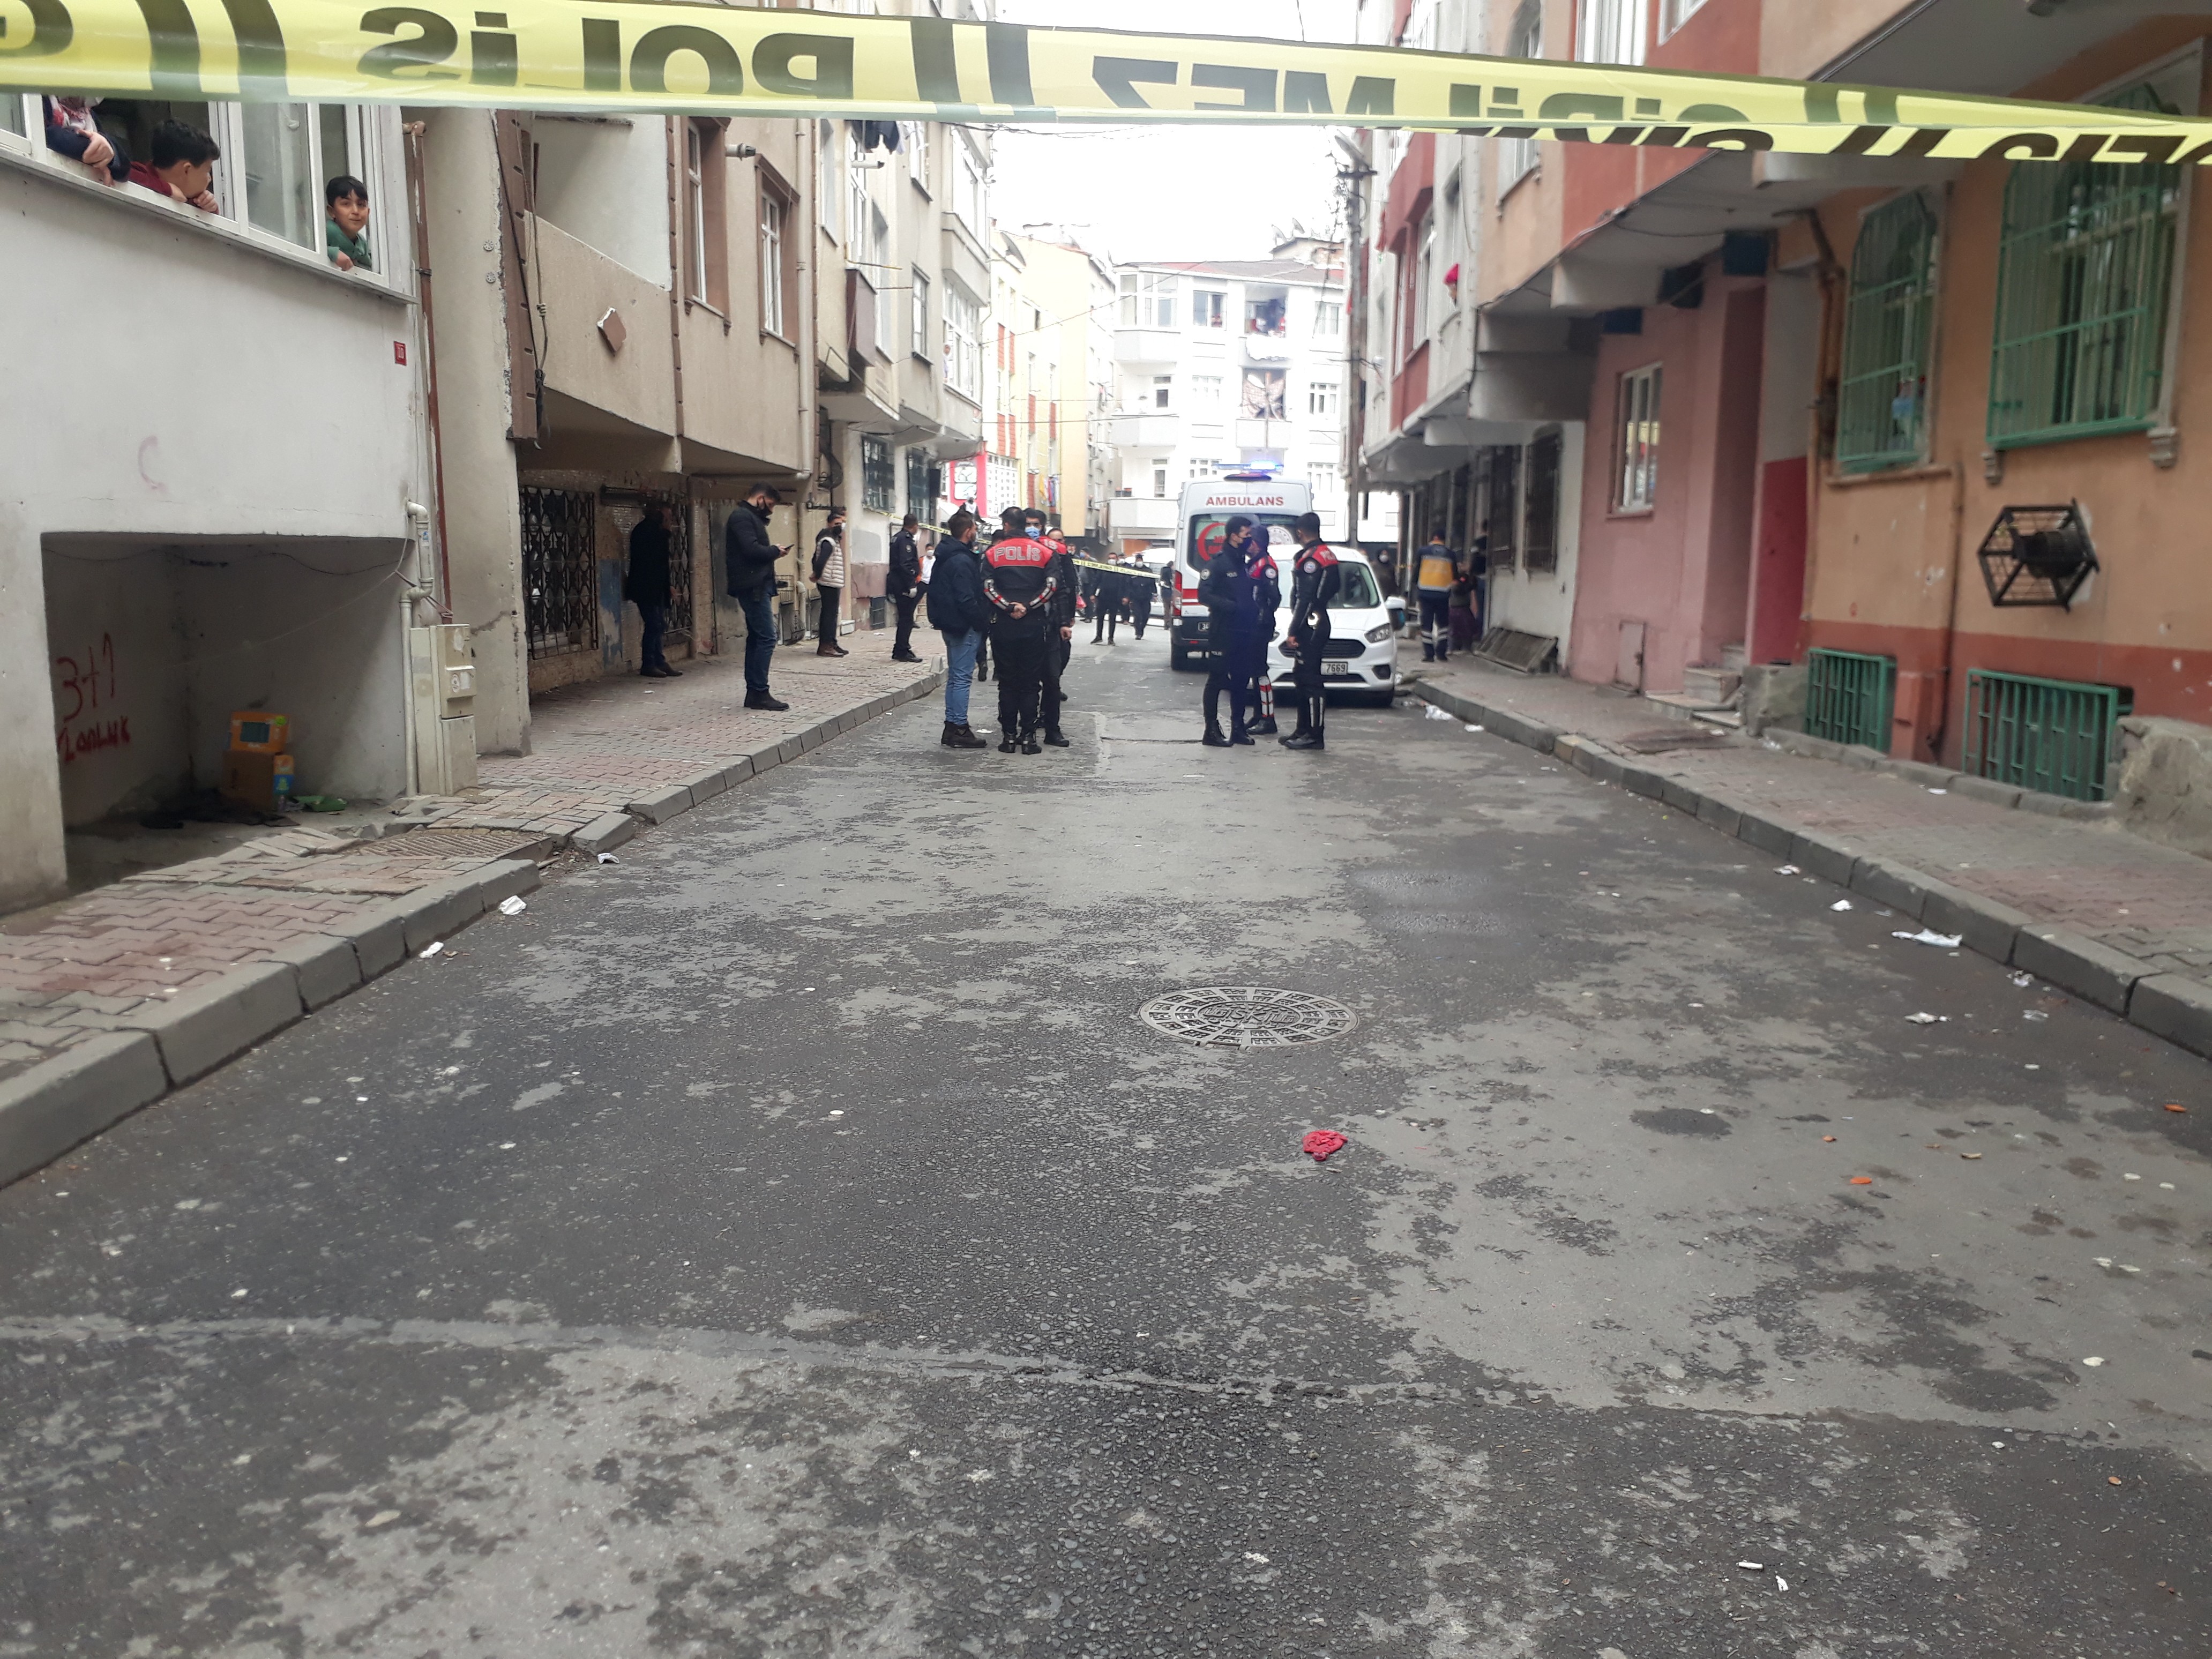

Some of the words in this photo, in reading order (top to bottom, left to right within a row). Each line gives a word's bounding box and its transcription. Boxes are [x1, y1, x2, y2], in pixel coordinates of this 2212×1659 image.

[1206, 497, 1284, 506] AMBULANS
[994, 544, 1041, 562] POLİS
[1326, 664, 1346, 672] 7669
